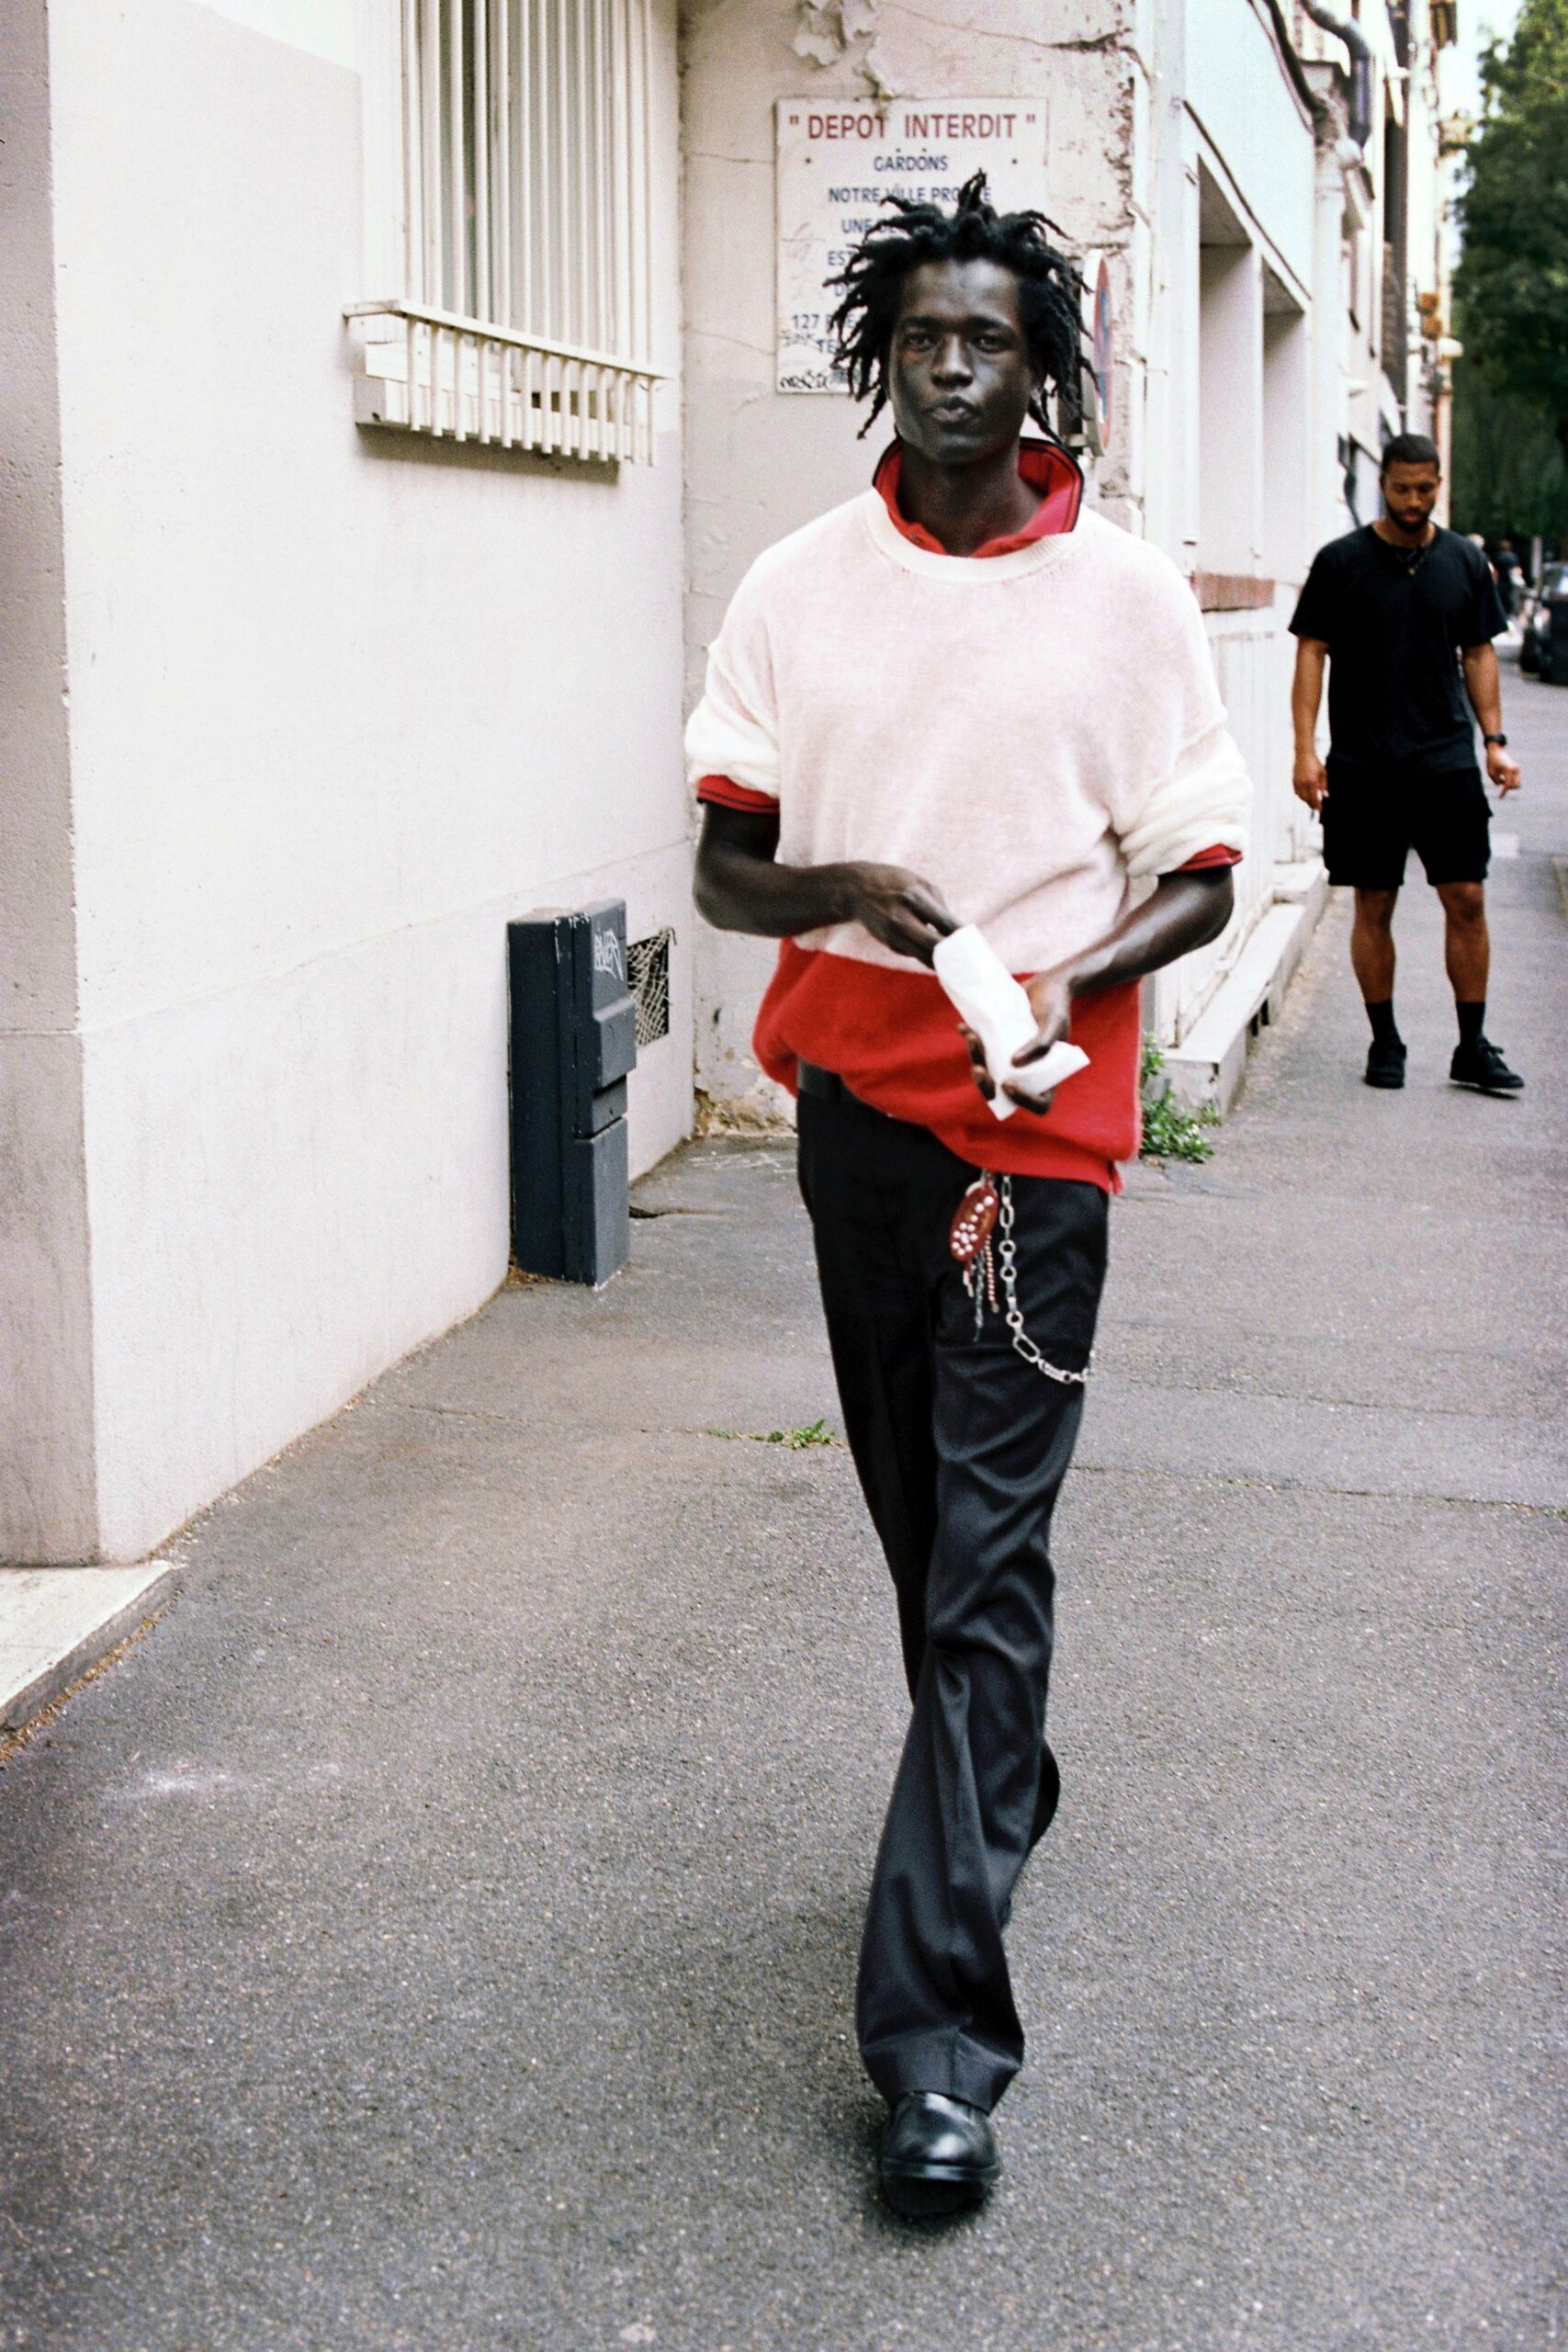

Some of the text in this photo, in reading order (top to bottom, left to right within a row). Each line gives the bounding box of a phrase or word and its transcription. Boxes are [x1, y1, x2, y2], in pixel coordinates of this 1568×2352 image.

[874, 155, 949, 172] GARDONS
[829, 187, 880, 203] NOTRE
[794, 313, 820, 330] 127
